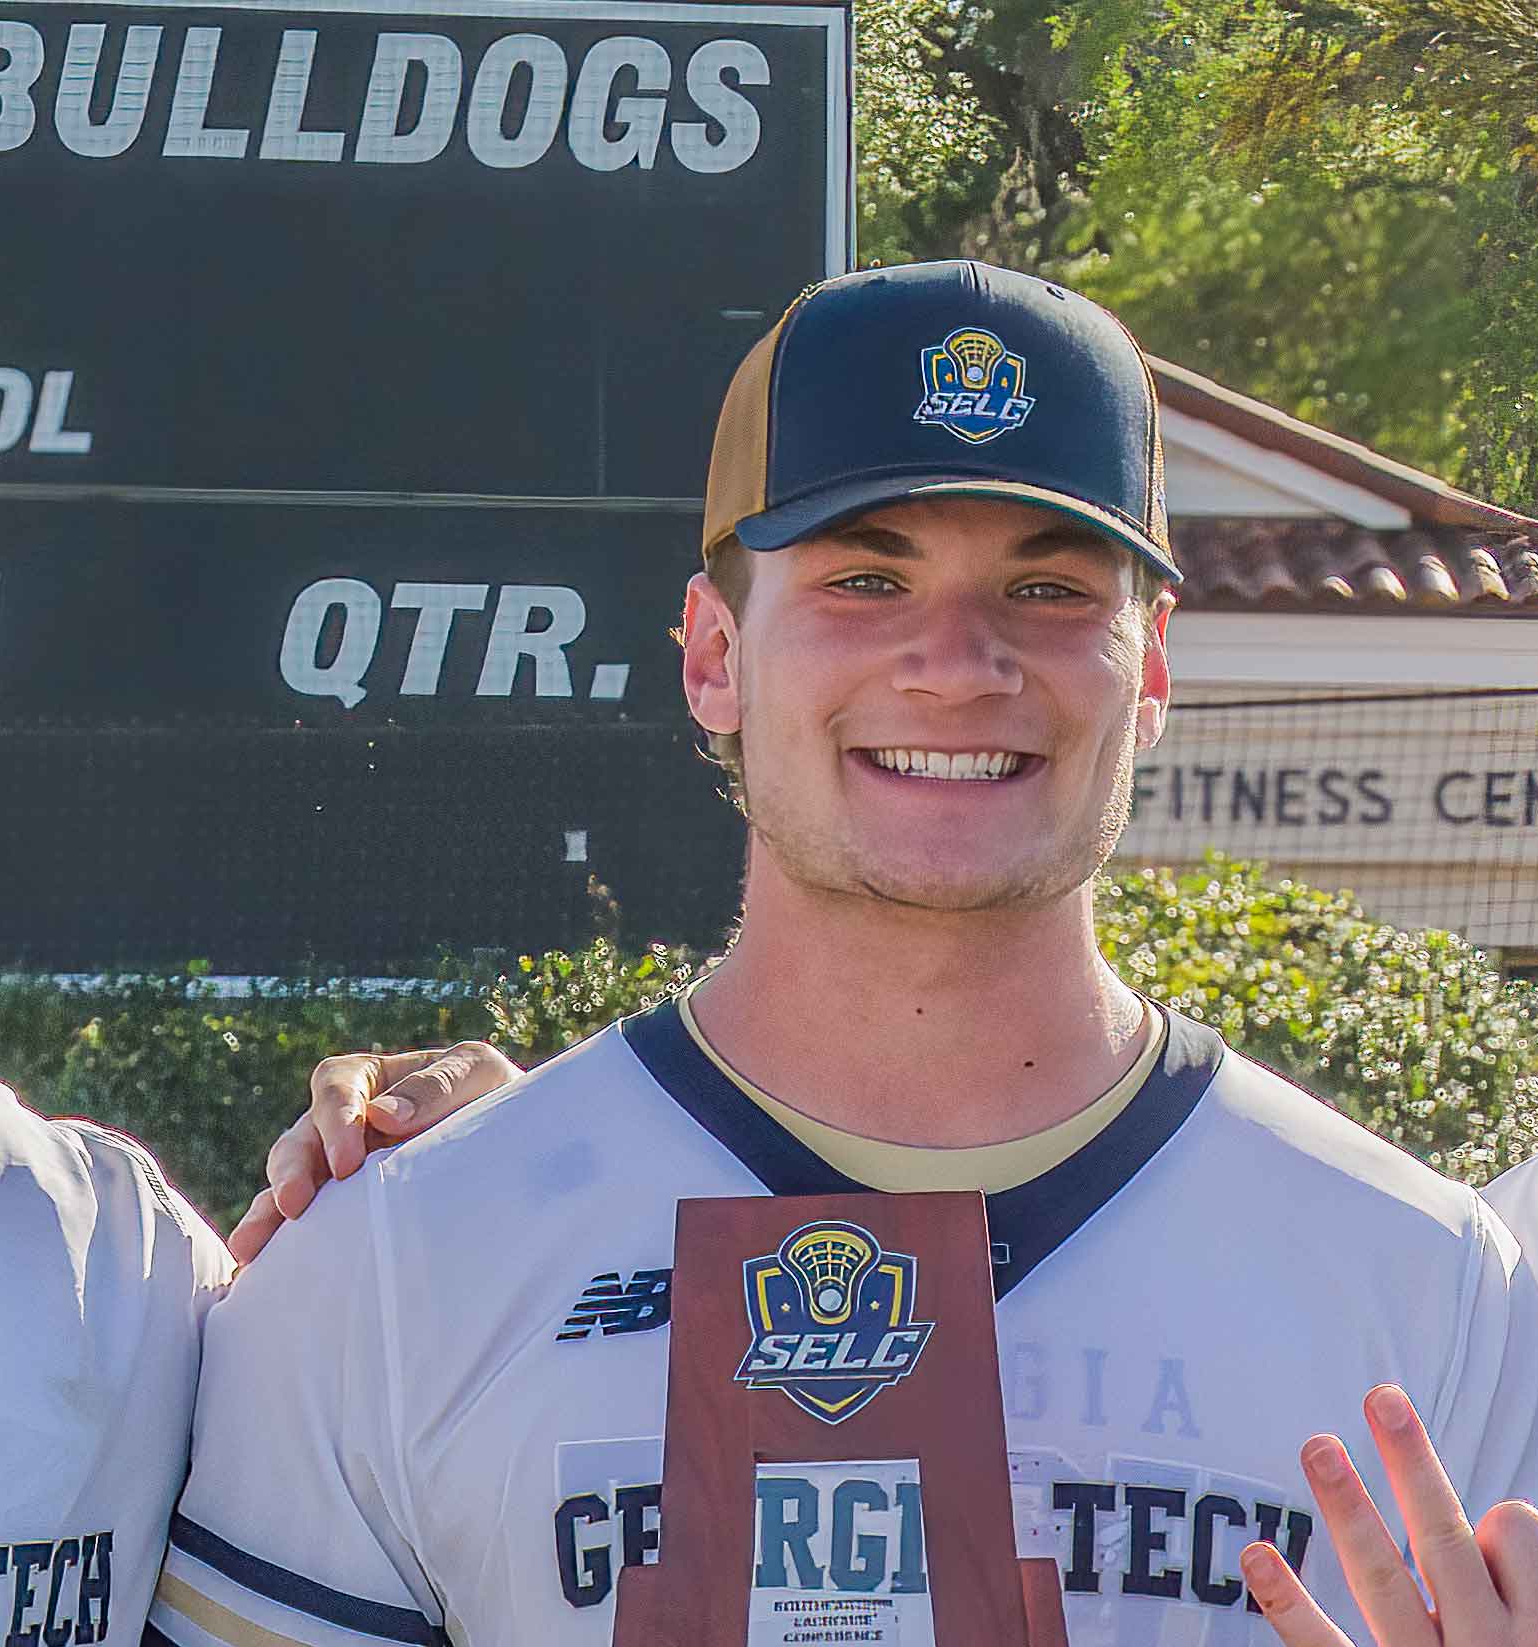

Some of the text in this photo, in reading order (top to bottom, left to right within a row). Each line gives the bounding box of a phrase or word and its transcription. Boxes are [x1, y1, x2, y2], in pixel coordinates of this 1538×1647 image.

[923, 391, 1029, 420] SELC
[279, 577, 631, 709] QTR.
[1135, 765, 1393, 825] FITNESS
[749, 1330, 920, 1371] SELC
